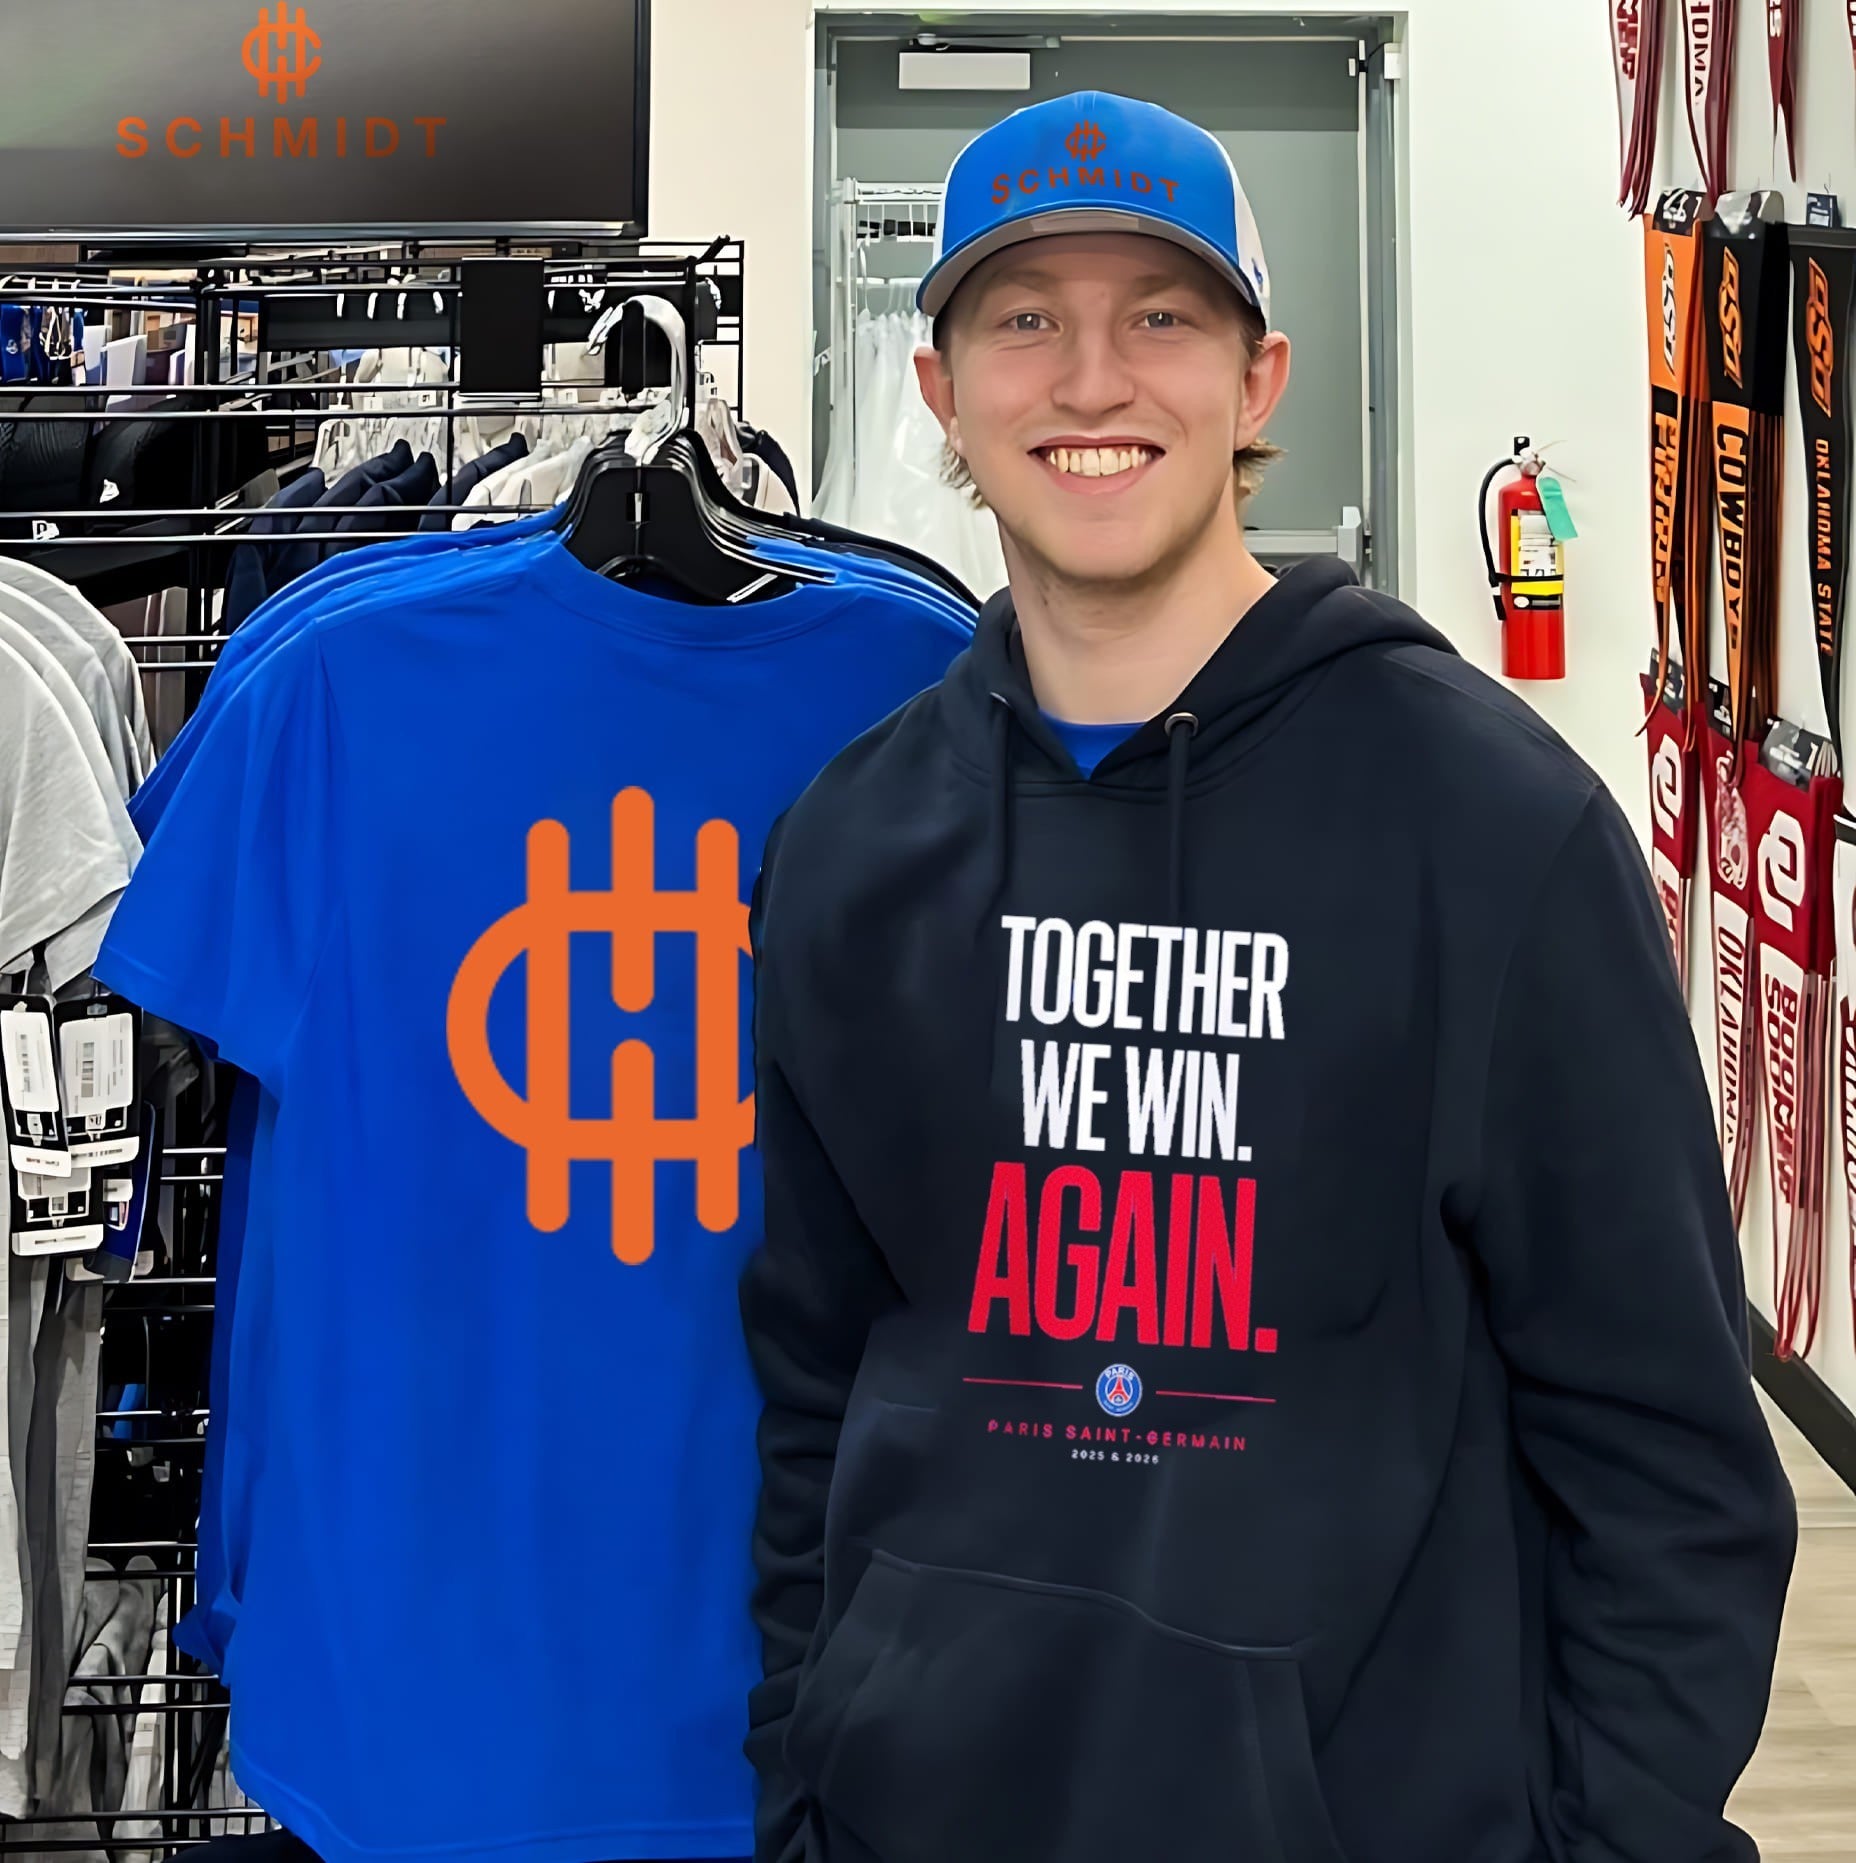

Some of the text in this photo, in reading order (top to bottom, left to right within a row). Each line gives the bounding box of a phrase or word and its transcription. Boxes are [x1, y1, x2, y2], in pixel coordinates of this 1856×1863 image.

[115, 115, 447, 159] SCHMIDT
[991, 167, 1179, 204] SCHMIDT
[1815, 438, 1832, 571] OKLAHOMA
[1001, 915, 1289, 1040] TOGETHER
[1718, 926, 1745, 1144] OKLAHOMA
[1020, 1039, 1252, 1162] WE WIN.
[968, 1161, 1278, 1353] AGAIN.
[1104, 1366, 1136, 1381] PARIS
[986, 1418, 1247, 1451] PARIS SAINT-GERMAIN
[1071, 1448, 1105, 1461] 2025
[1125, 1452, 1159, 1465] 2026
